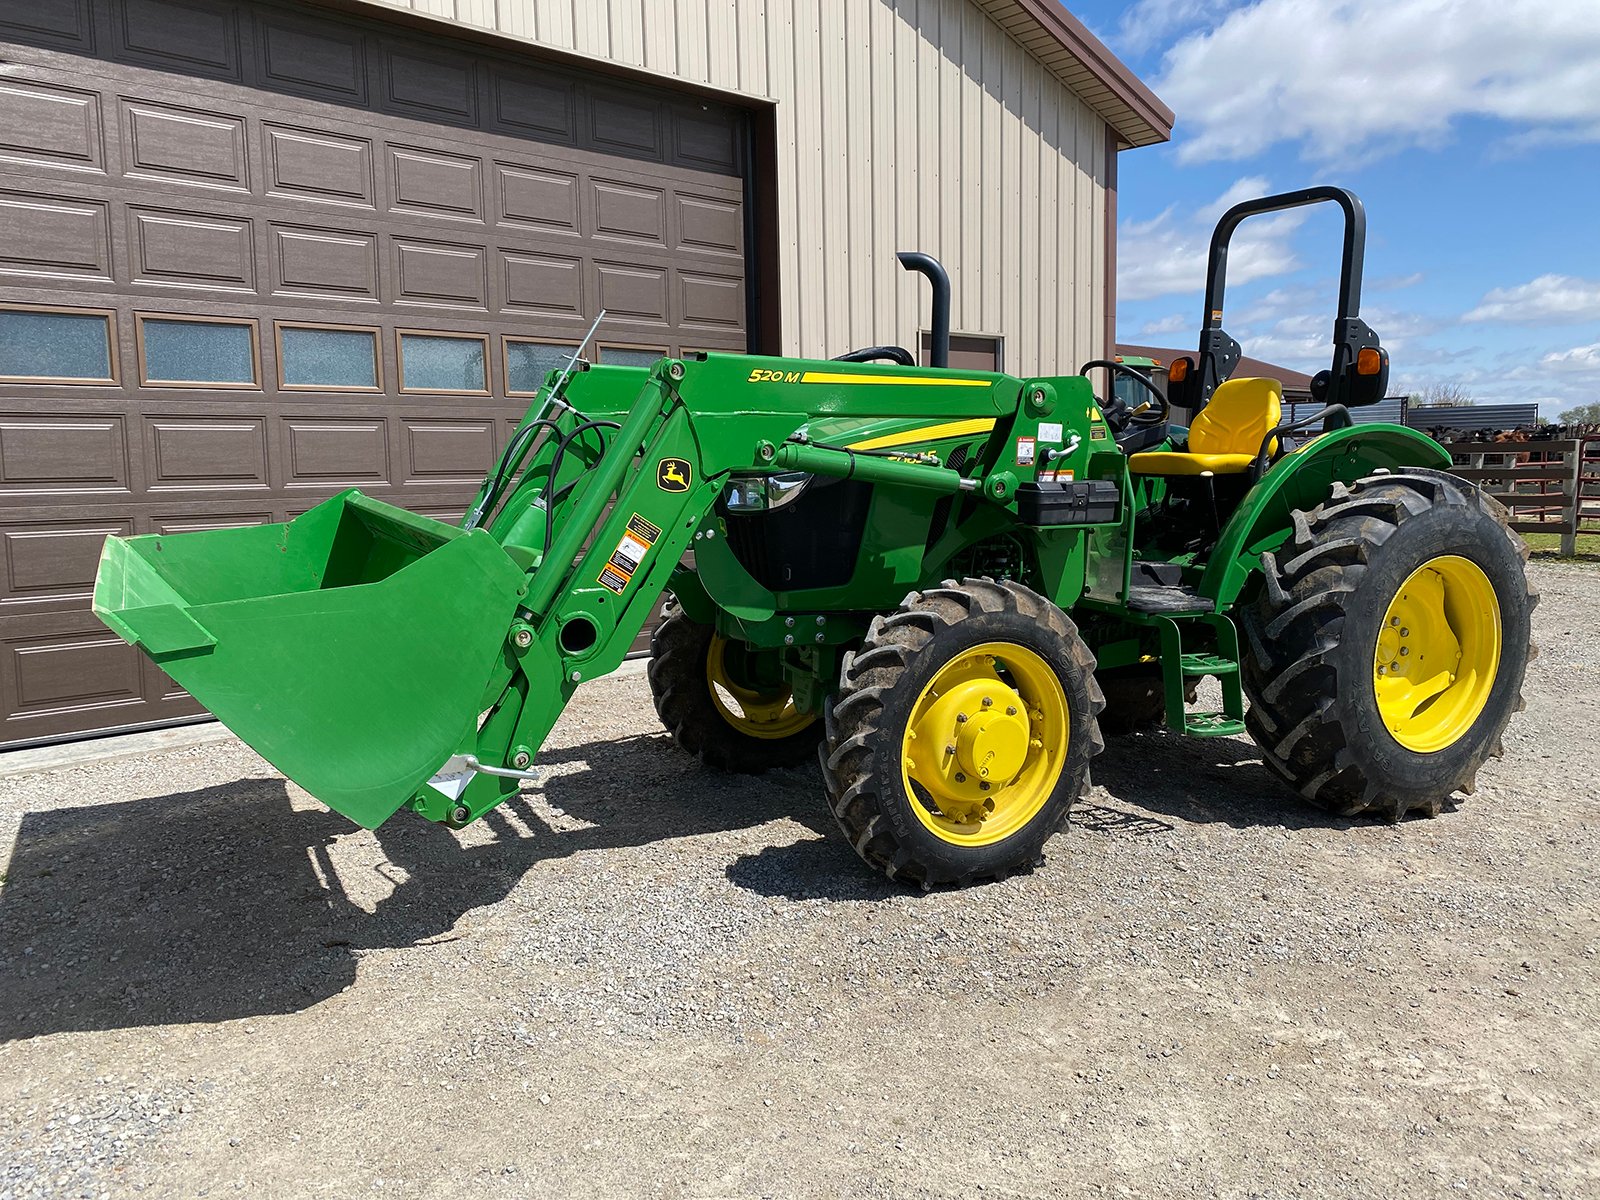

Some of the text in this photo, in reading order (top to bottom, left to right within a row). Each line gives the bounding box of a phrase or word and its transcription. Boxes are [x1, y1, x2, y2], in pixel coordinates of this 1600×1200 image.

[747, 368, 801, 383] 520 M
[1059, 647, 1089, 782] GALAXY
